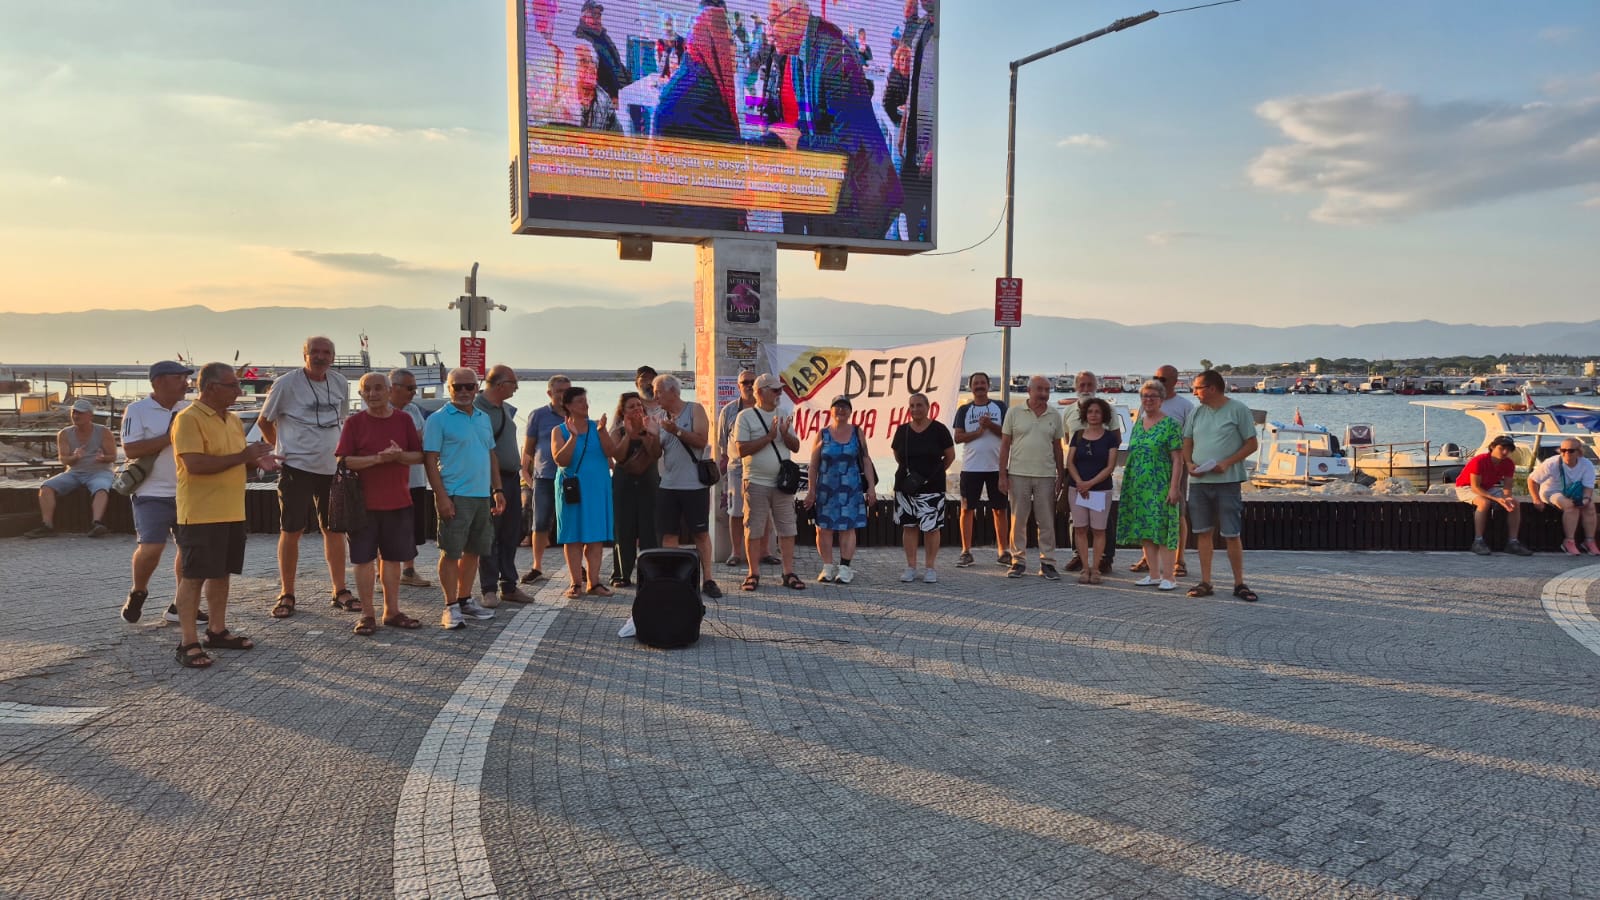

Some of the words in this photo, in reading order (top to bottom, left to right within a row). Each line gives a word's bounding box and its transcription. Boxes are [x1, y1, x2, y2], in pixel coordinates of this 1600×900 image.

[613, 169, 635, 183] için
[703, 158, 715, 169] ve
[718, 157, 750, 173] sosyal
[791, 355, 829, 395] ABD
[843, 355, 939, 400] DEFOL
